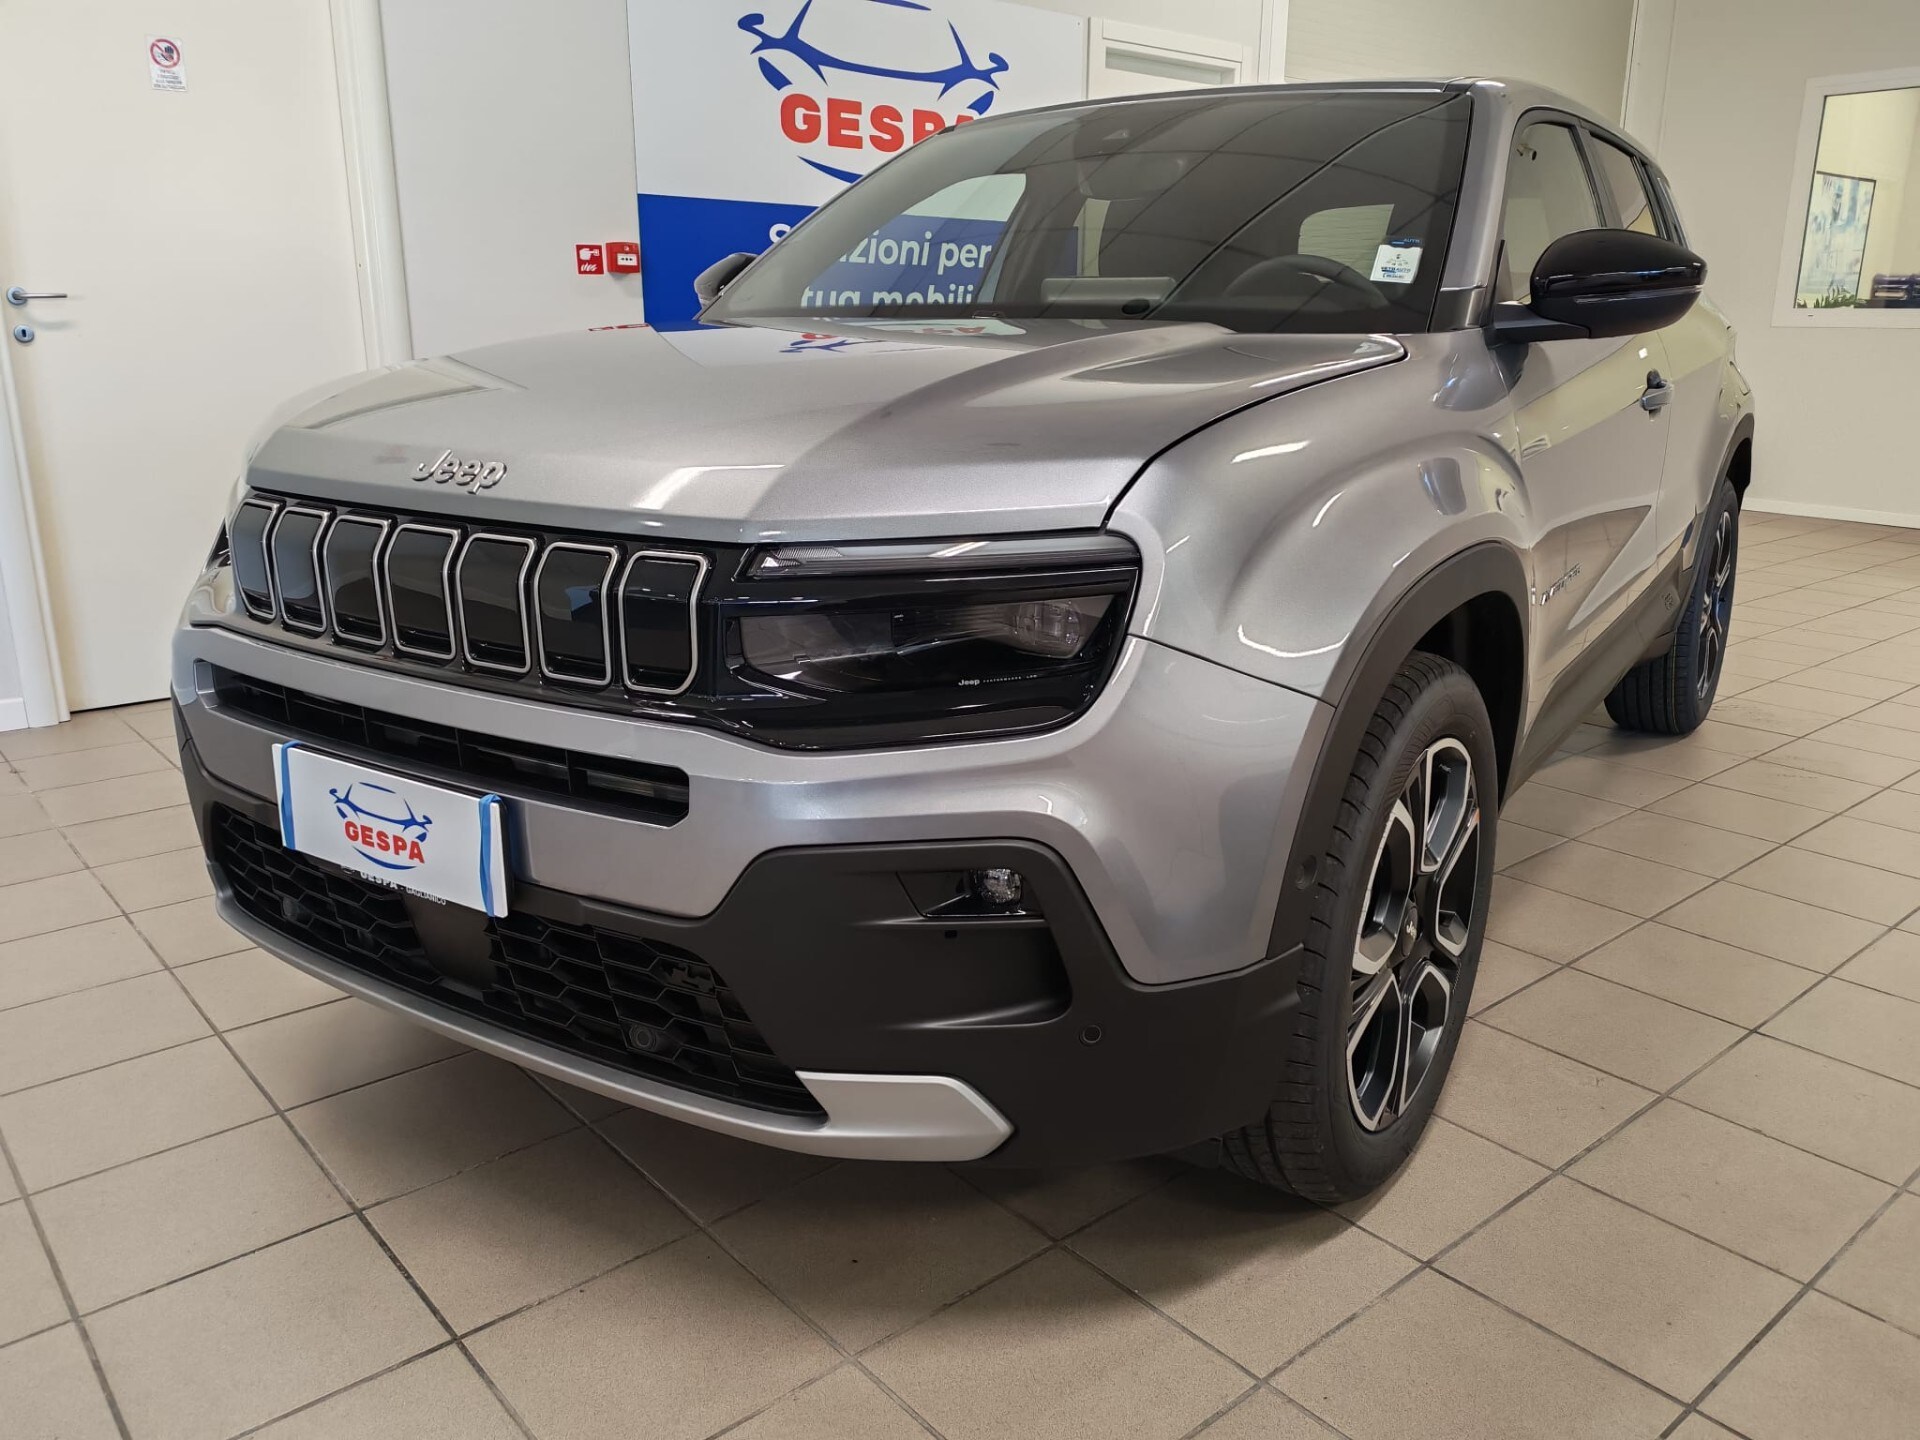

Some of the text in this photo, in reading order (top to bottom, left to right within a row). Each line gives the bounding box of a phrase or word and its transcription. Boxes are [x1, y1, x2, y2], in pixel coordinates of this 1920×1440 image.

[780, 93, 975, 153] GESP
[937, 242, 993, 276] per
[411, 449, 507, 495] Jeep
[344, 820, 425, 864] GESPA
